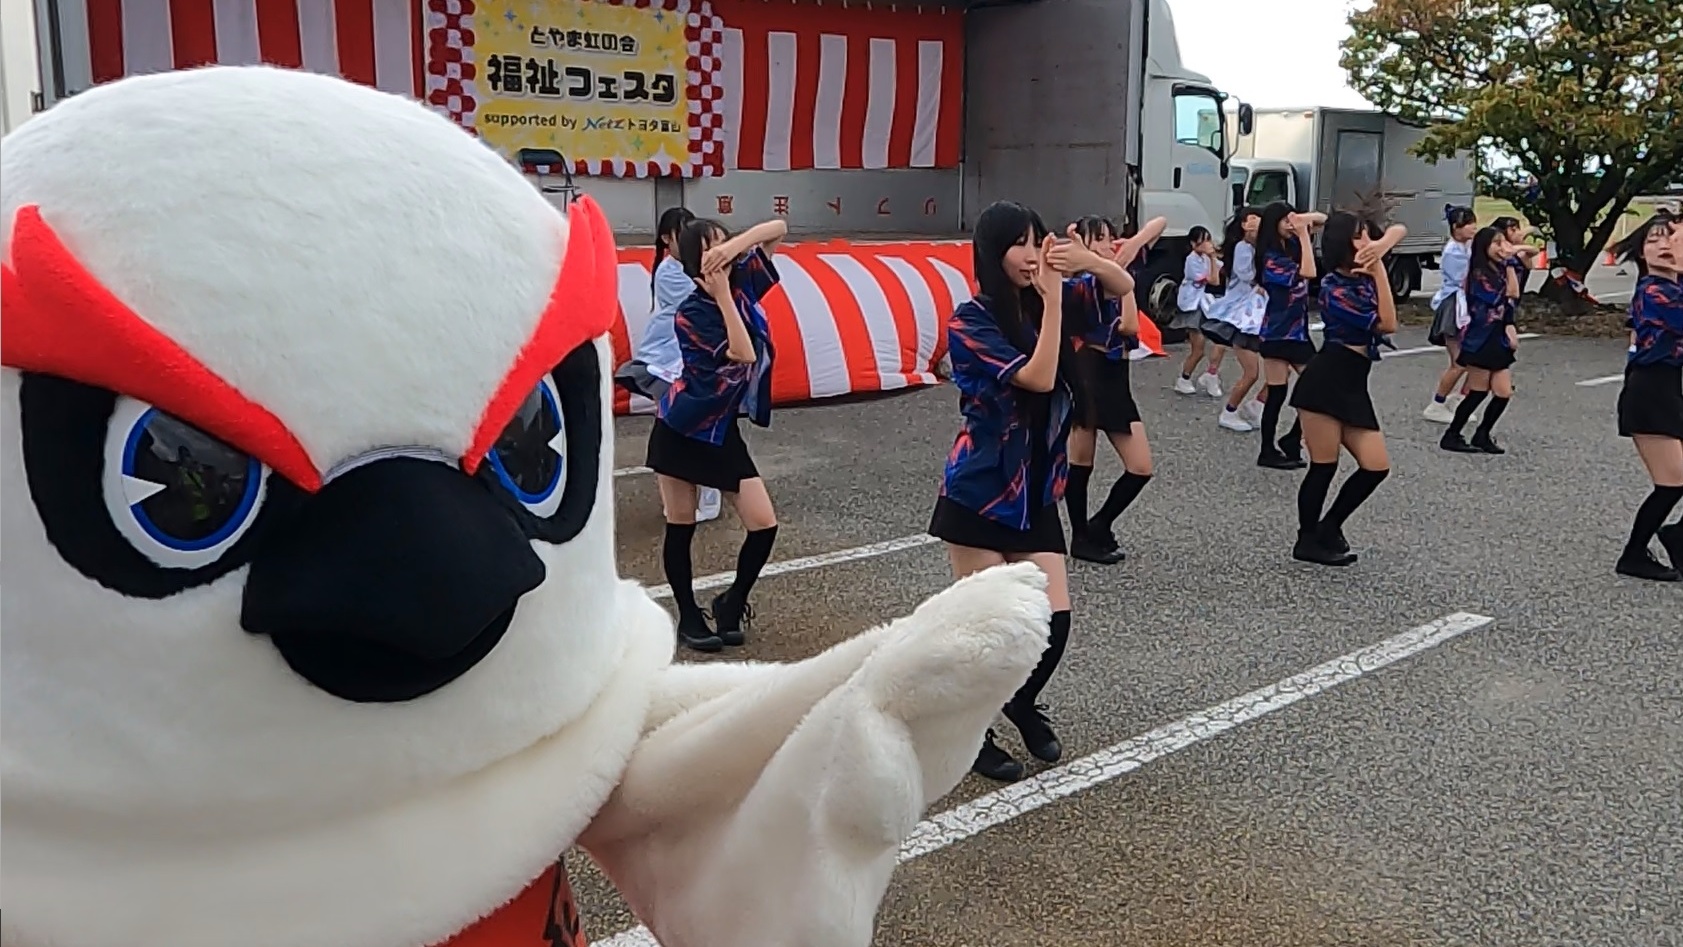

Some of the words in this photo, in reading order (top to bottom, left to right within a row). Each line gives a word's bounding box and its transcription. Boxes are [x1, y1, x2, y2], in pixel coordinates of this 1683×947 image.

[487, 54, 675, 102] 福祉フェスタ
[484, 112, 557, 127] supported
[561, 114, 578, 130] by
